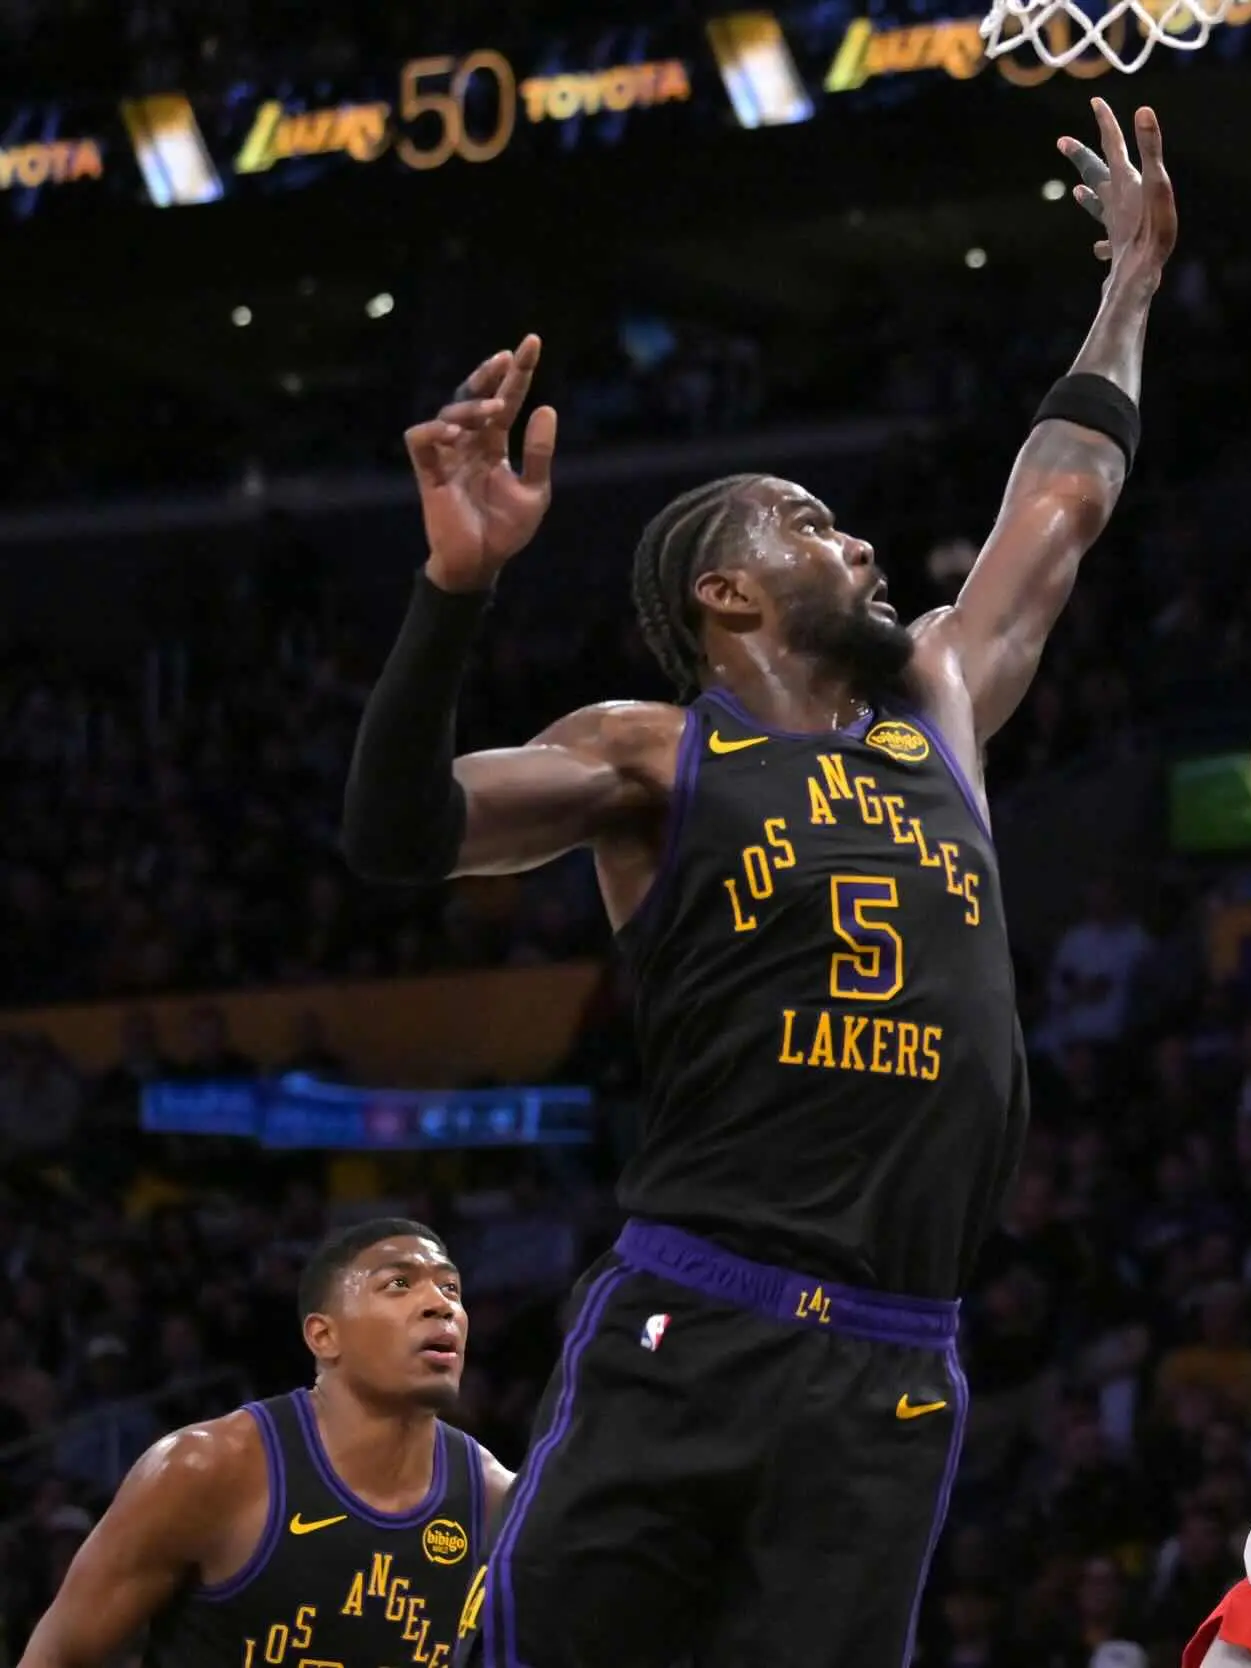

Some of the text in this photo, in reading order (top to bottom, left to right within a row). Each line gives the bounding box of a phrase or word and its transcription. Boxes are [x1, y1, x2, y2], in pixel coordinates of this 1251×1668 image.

[400, 49, 515, 169] 50
[520, 58, 690, 123] TOYOTA
[724, 753, 980, 932] LOS ANGELES
[829, 874, 904, 1001] 5
[778, 1009, 943, 1081] LAKERS
[796, 1286, 831, 1324] LAL
[427, 1530, 465, 1552] bibigo
